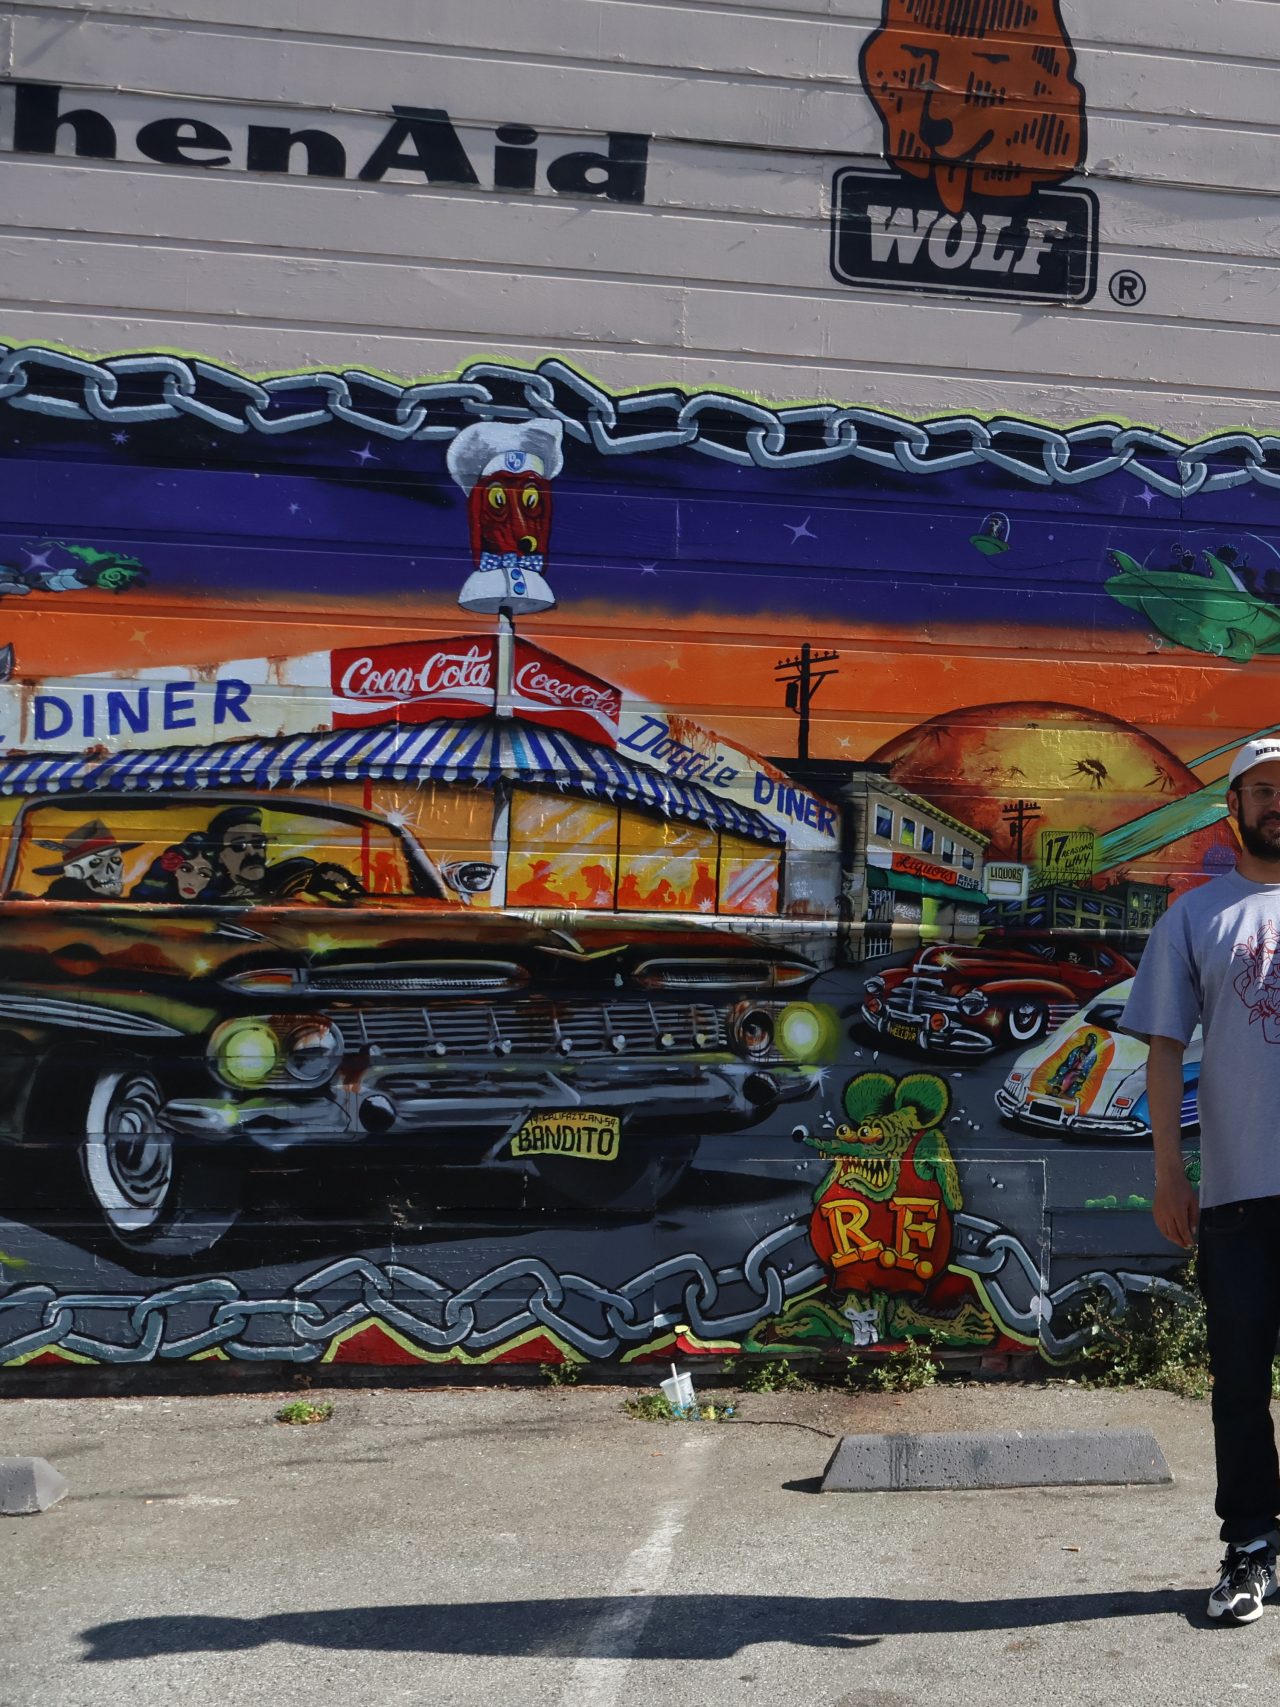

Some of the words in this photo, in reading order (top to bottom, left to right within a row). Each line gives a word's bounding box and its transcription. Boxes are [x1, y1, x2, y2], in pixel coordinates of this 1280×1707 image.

[13, 83, 650, 205] henAid
[866, 204, 1068, 276] WOLF
[341, 645, 493, 700] Coca-Cola
[34, 678, 252, 741] DINER
[618, 715, 740, 788] Doggie
[753, 771, 836, 838] DINER
[990, 866, 1024, 880] LIQUORS
[1045, 835, 1069, 867] 17
[1061, 841, 1093, 857] REASONS
[1065, 853, 1091, 868] WHY
[518, 1124, 615, 1156] BANDITO
